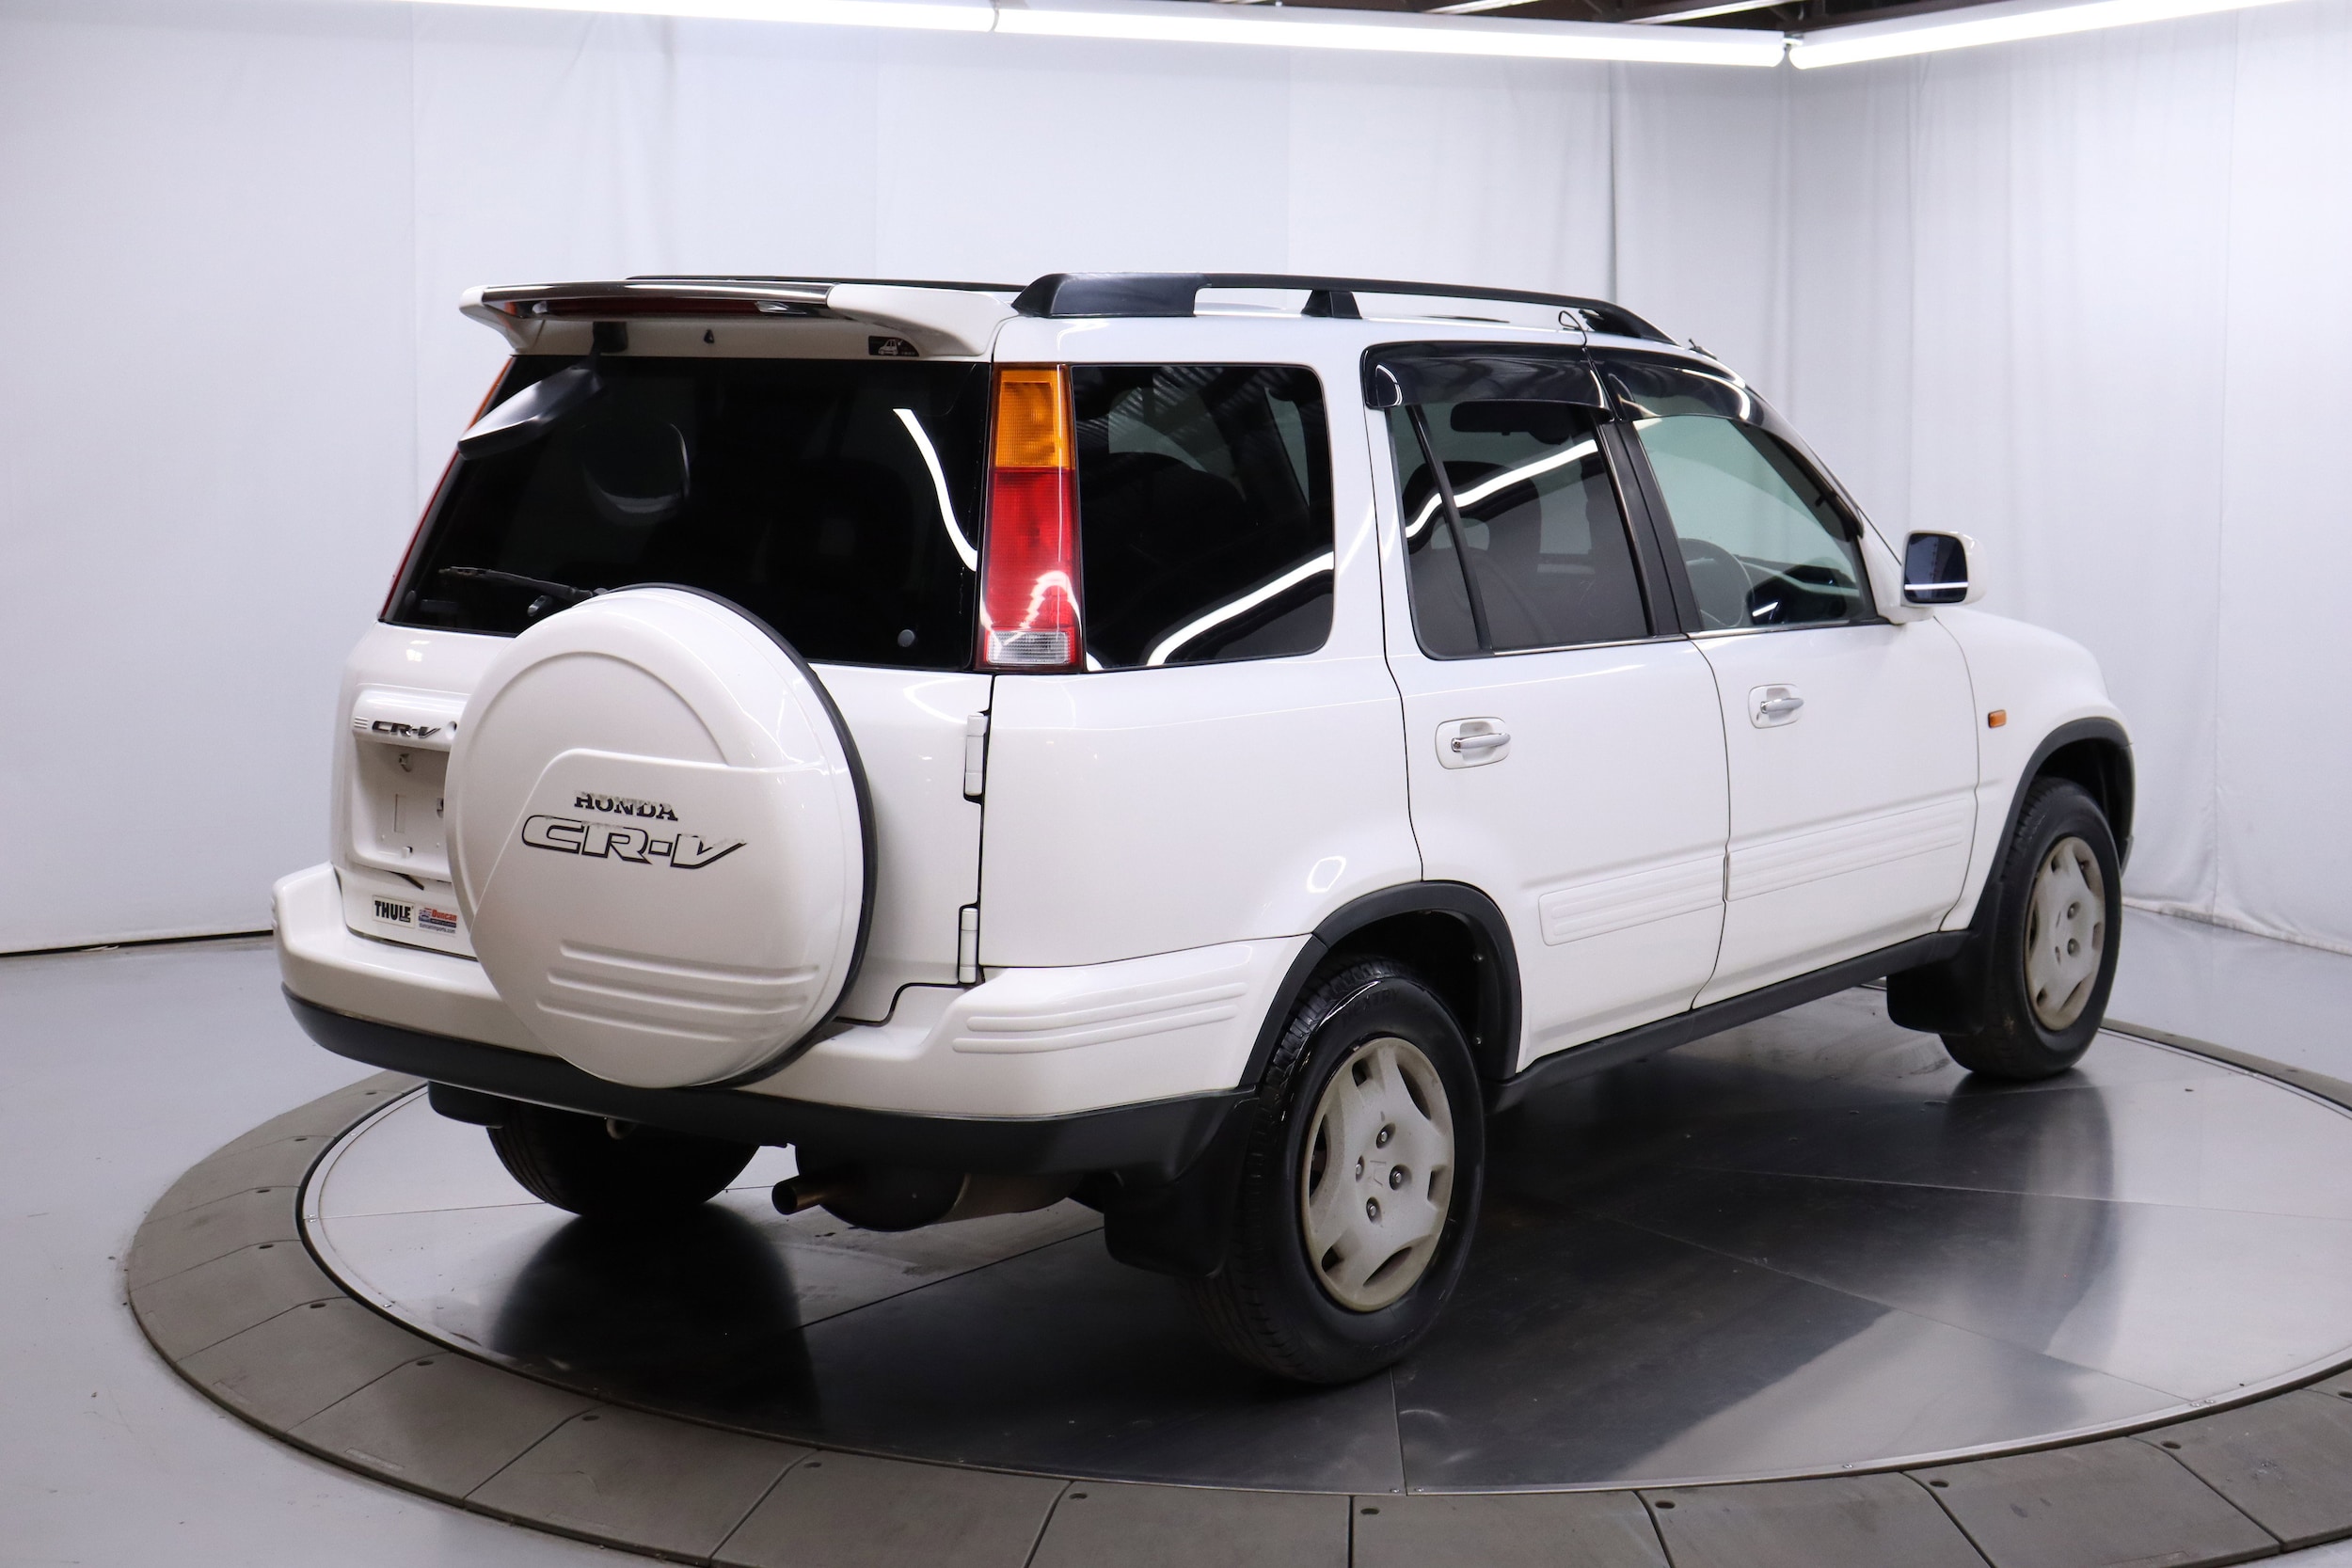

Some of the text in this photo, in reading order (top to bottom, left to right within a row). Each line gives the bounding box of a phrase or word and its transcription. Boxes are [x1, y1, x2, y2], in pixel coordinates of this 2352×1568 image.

[372, 720, 441, 738] CR-V
[573, 791, 678, 821] HONDA
[521, 815, 748, 869] CR-V
[374, 900, 411, 923] THULE
[431, 909, 457, 922] Duncan
